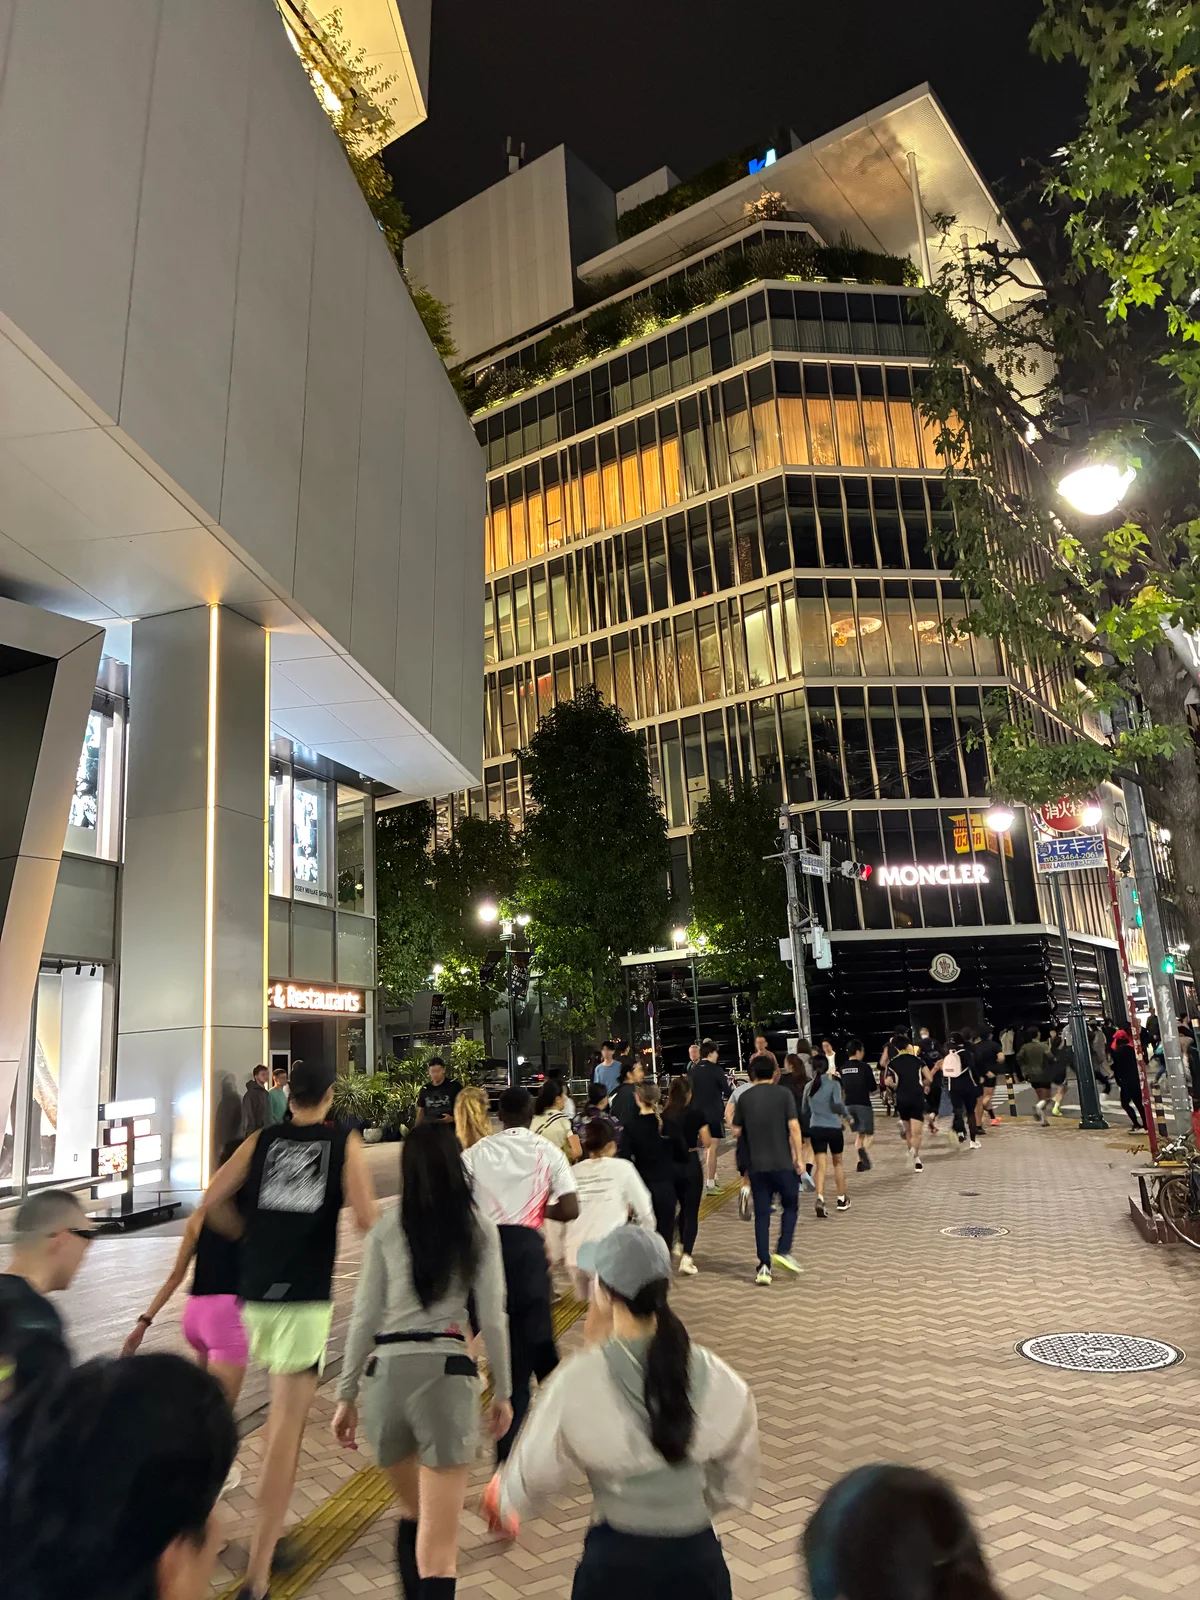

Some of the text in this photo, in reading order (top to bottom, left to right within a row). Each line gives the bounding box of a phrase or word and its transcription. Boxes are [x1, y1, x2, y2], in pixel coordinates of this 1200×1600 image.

[1053, 837, 1103, 855] セキネ
[878, 864, 989, 886] MONCLER
[286, 985, 360, 1012] Restaurants
